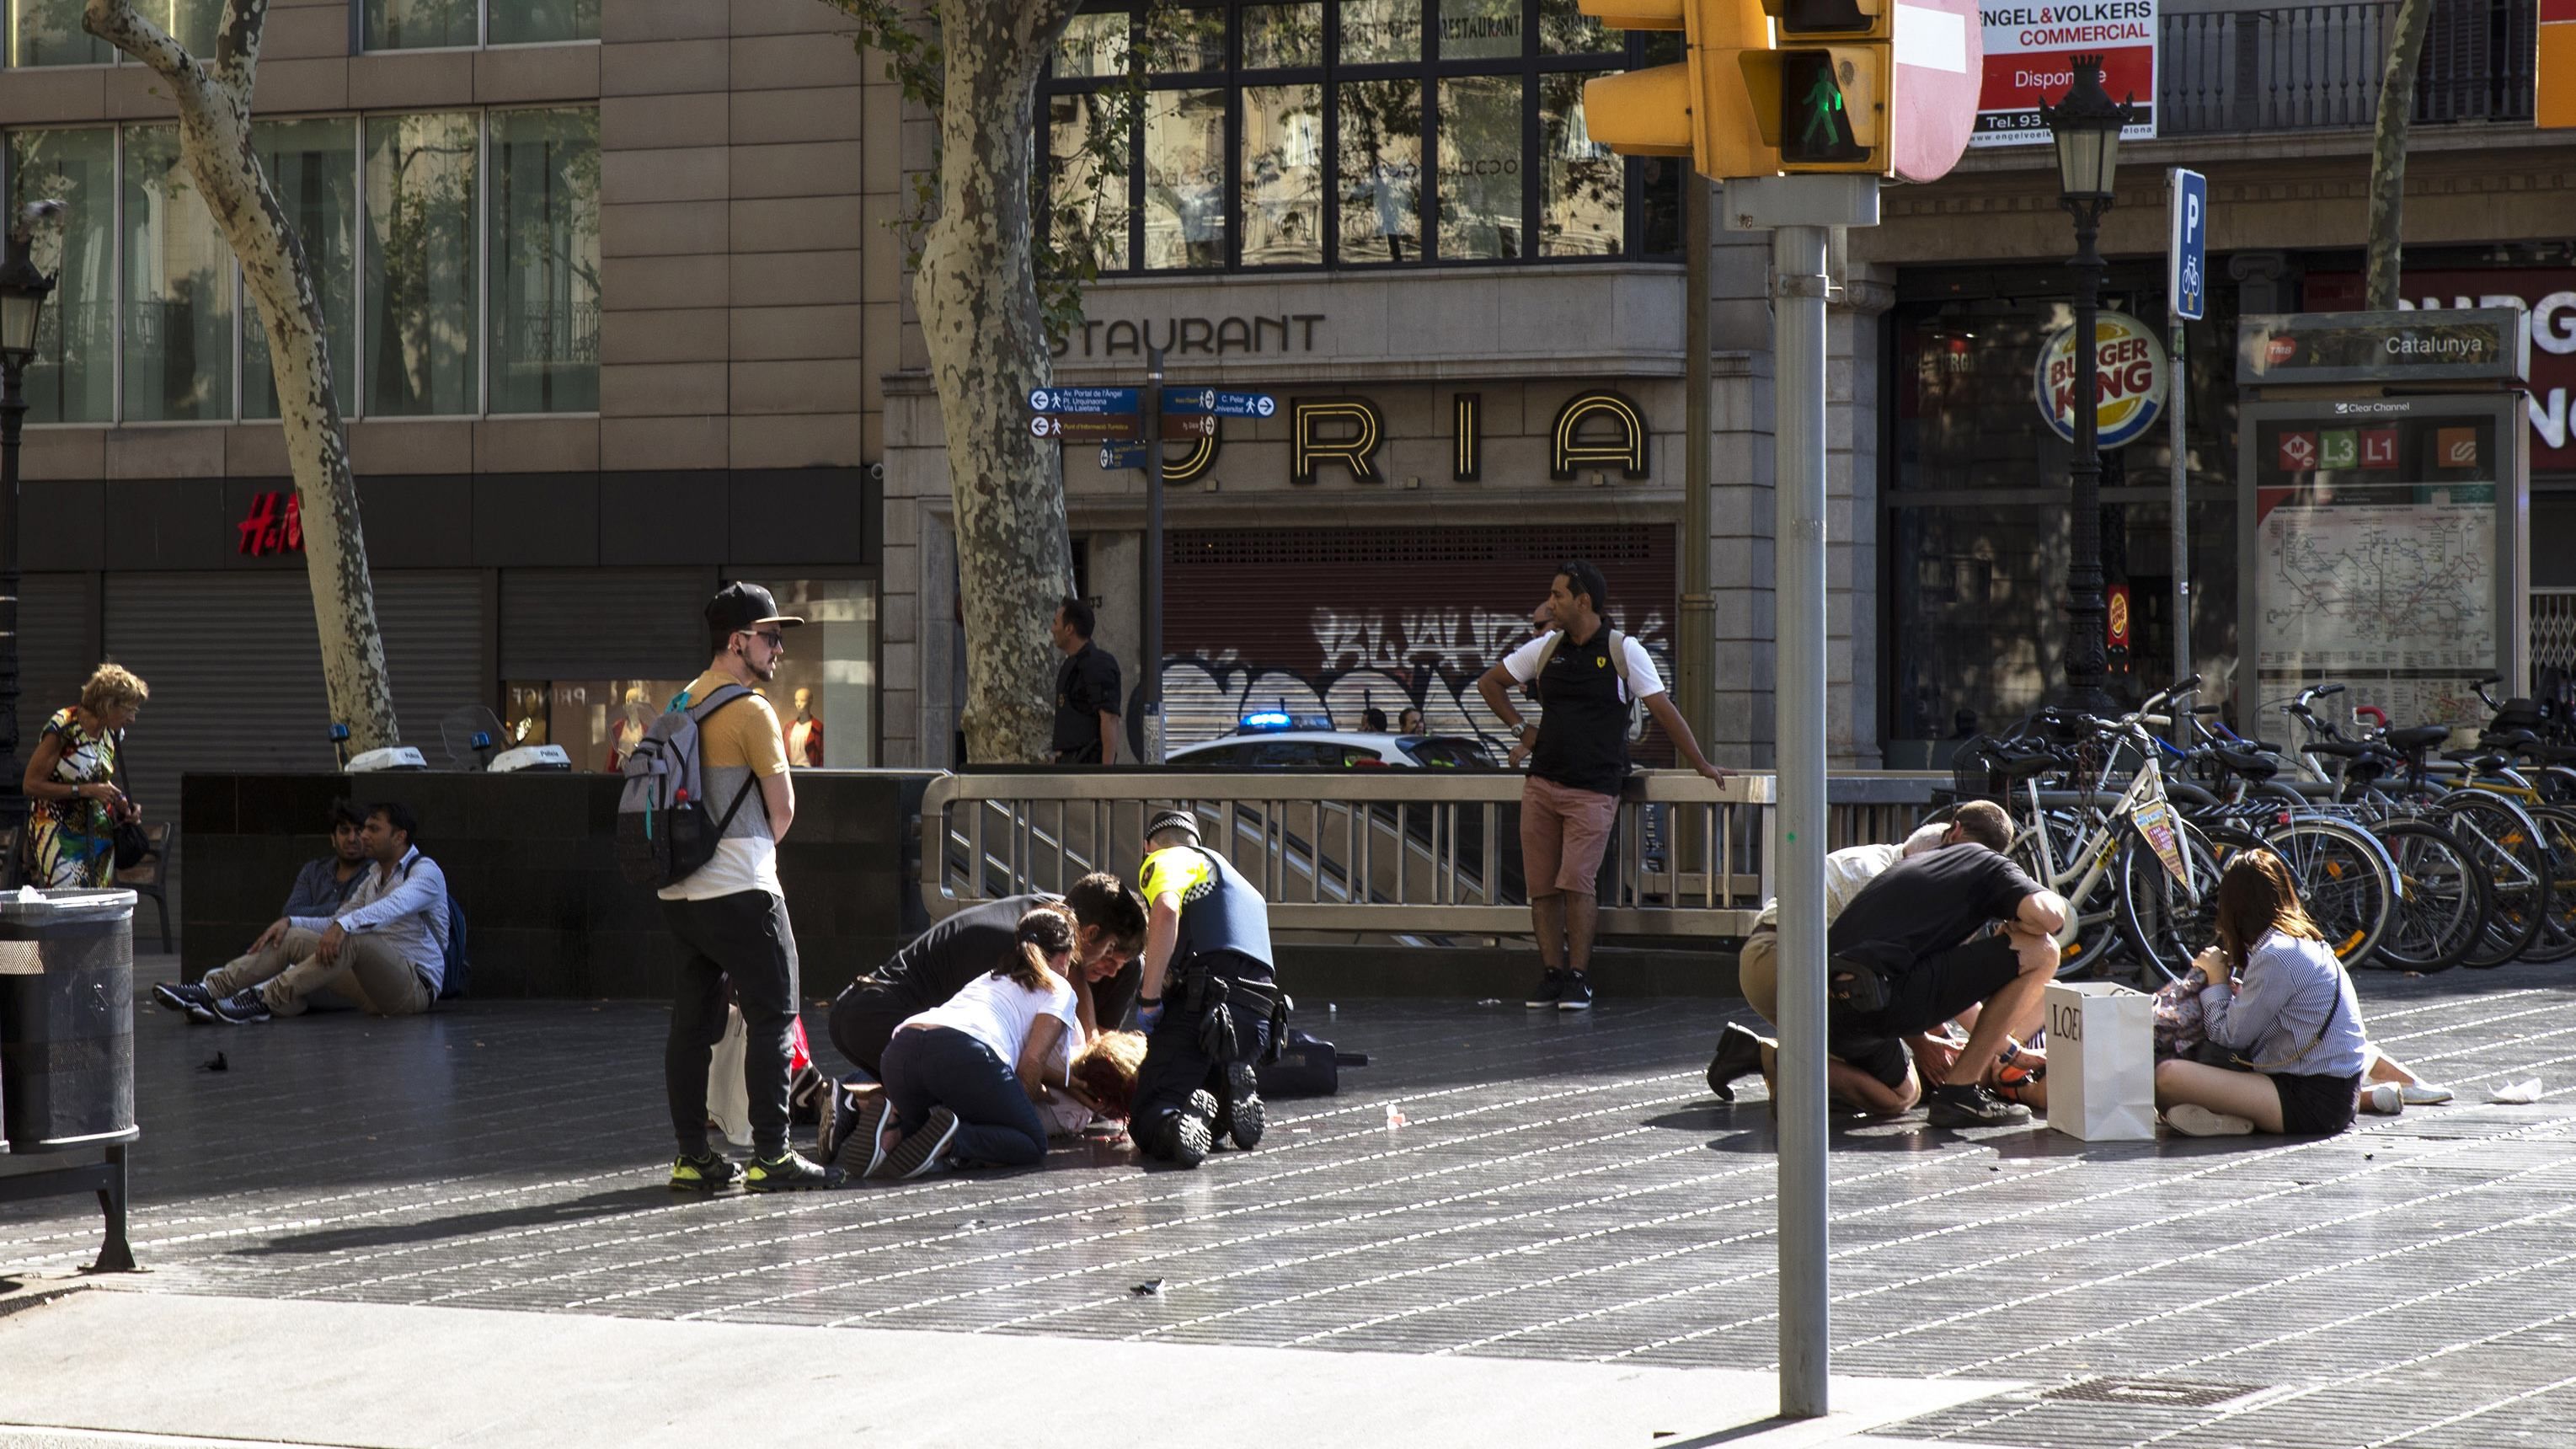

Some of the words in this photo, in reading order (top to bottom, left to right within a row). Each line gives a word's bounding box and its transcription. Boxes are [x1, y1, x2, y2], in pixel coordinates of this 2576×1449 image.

[1440, 14, 1520, 40] RESTAURANT
[2020, 23, 2150, 45] COMMERCIAL
[2015, 70, 2107, 89] Dispone
[1986, 116, 2015, 128] Tel.
[2019, 115, 2041, 126] 93
[2187, 193, 2199, 244] P
[2386, 336, 2482, 356] Catalunya
[2051, 338, 2148, 387] BUGER
[2055, 361, 2152, 420] KNG
[1072, 398, 1107, 406] Urquinaona
[2349, 404, 2372, 412] Clear
[2373, 402, 2410, 411] Channel
[2291, 441, 2305, 453] M
[2322, 439, 2354, 462] L3
[2367, 438, 2392, 461] L1
[2053, 1003, 2082, 1042] LOE
